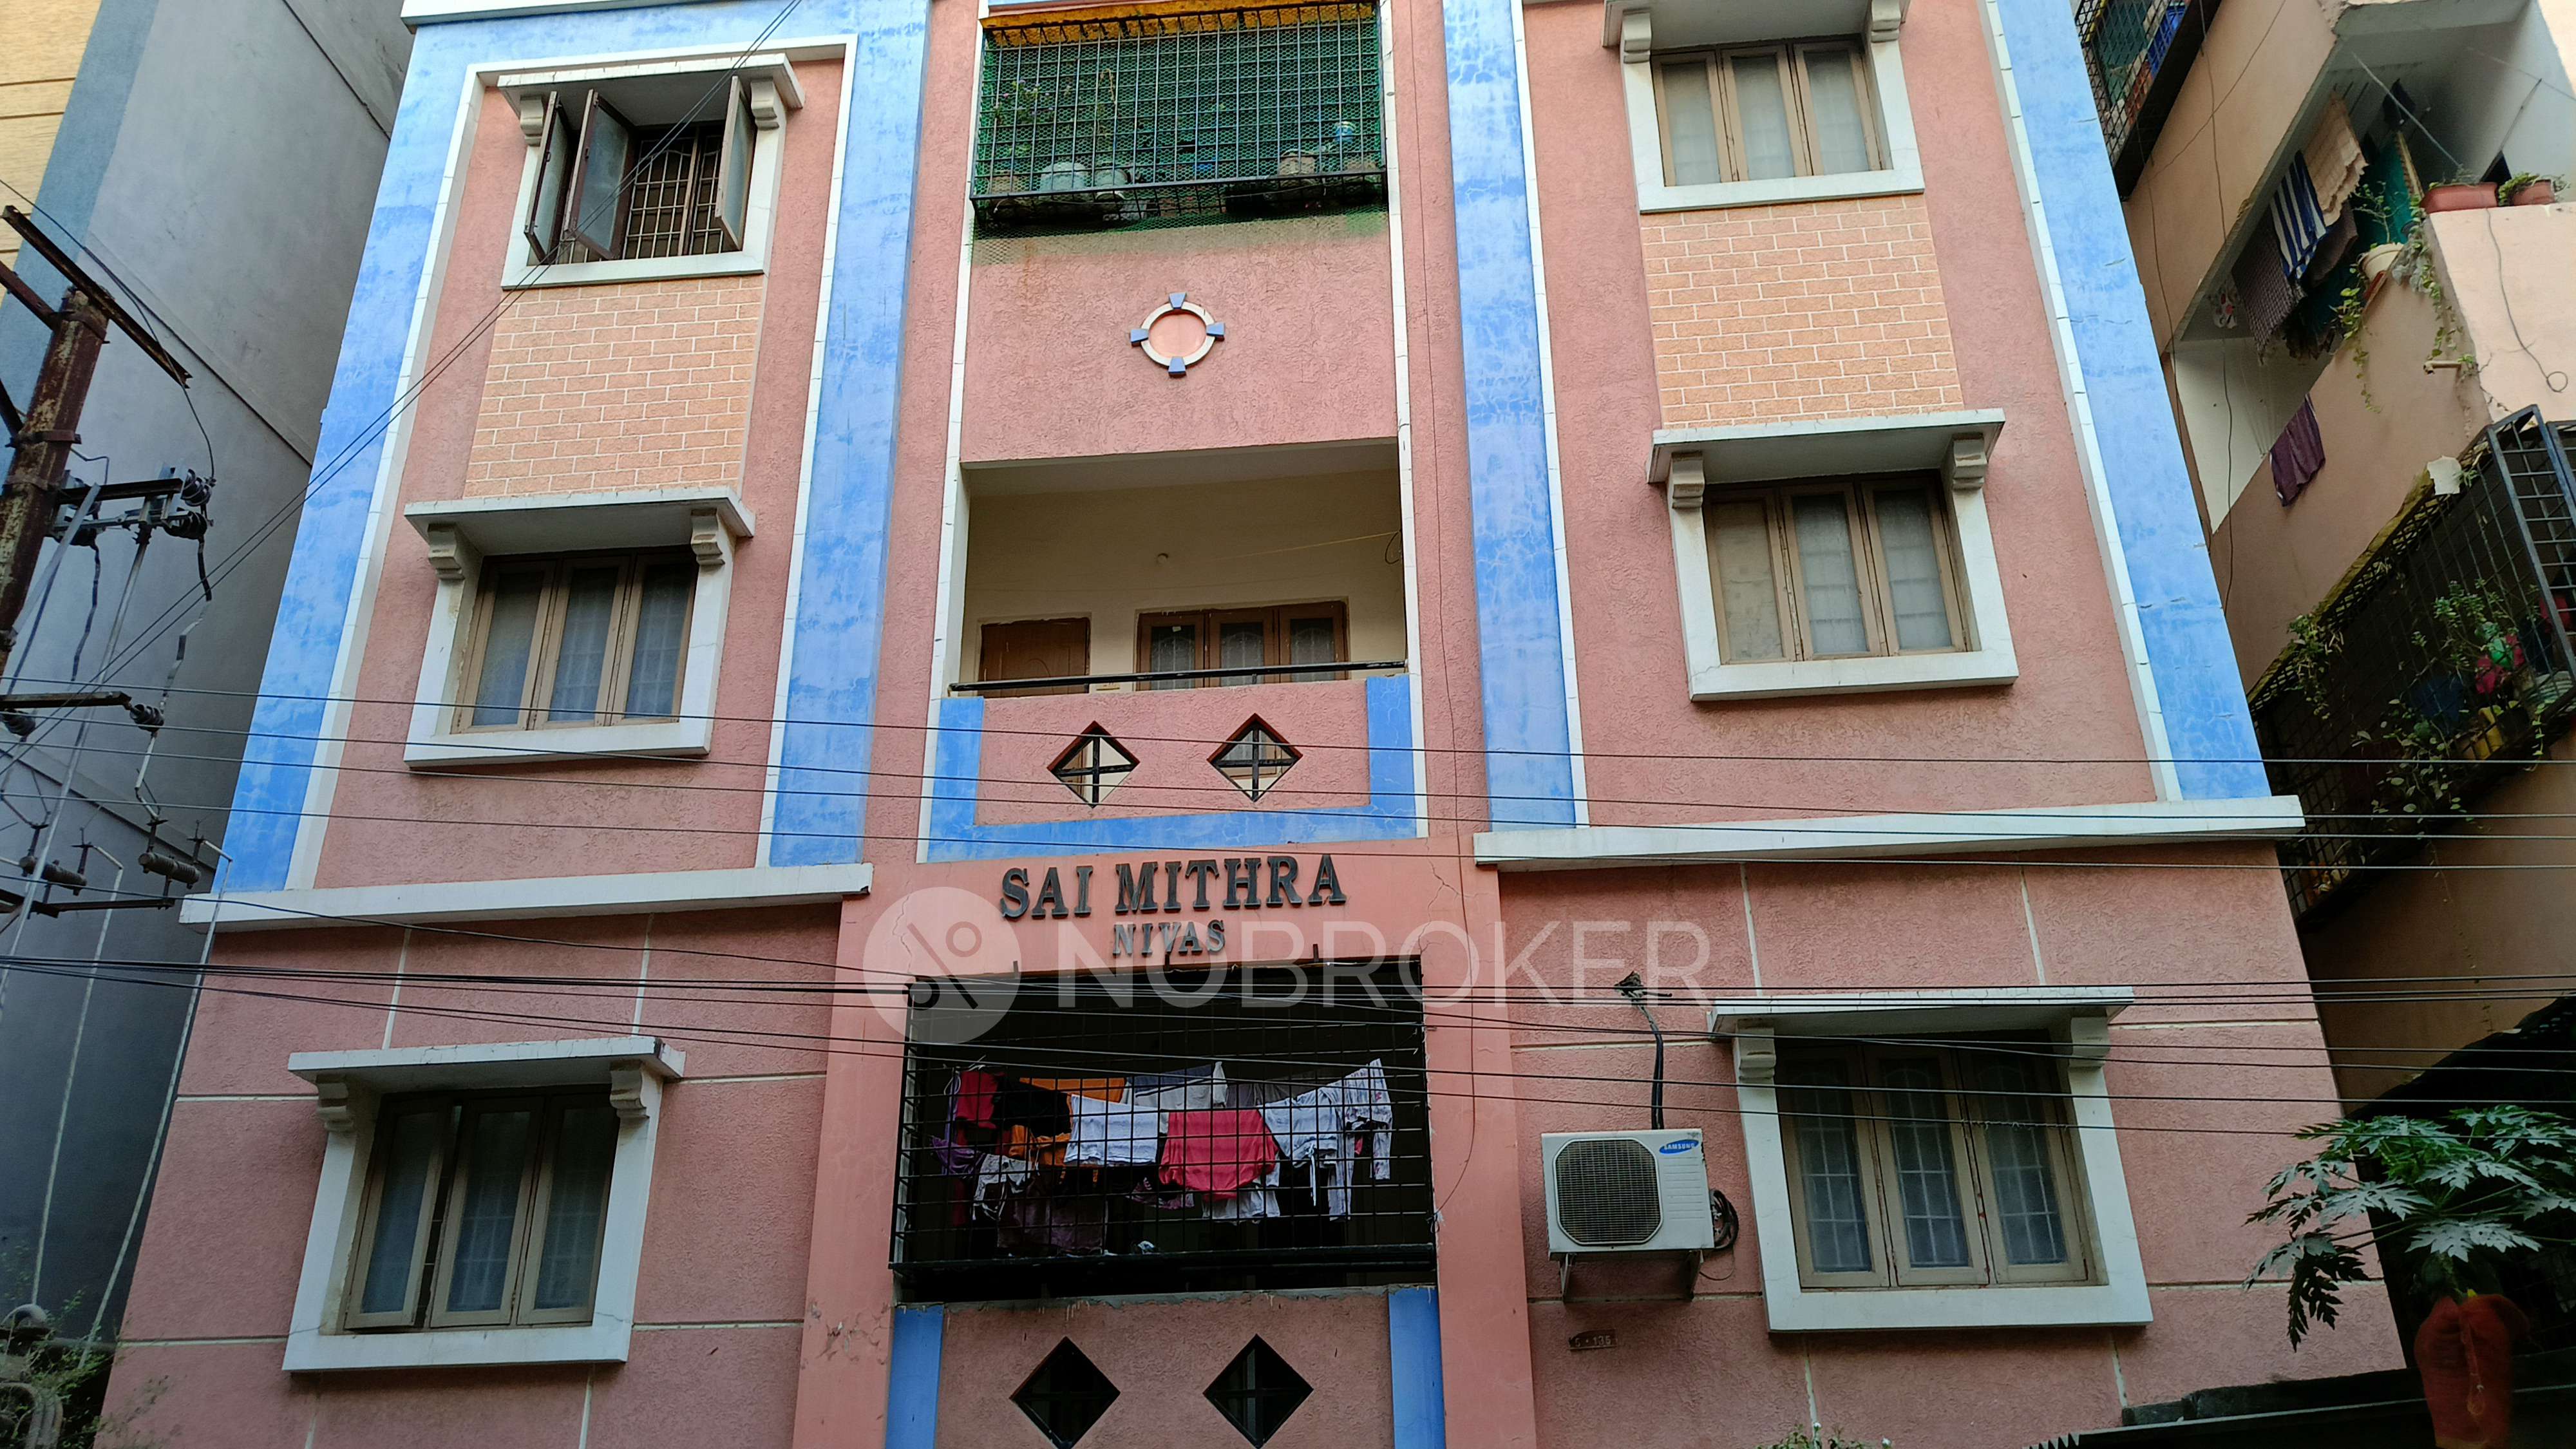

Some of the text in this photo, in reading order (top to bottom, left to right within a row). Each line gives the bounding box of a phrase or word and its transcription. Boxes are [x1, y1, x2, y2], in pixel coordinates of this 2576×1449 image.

[1001, 855, 1347, 919] SAI MITHRA
[1112, 919, 1226, 956] NIVAS
